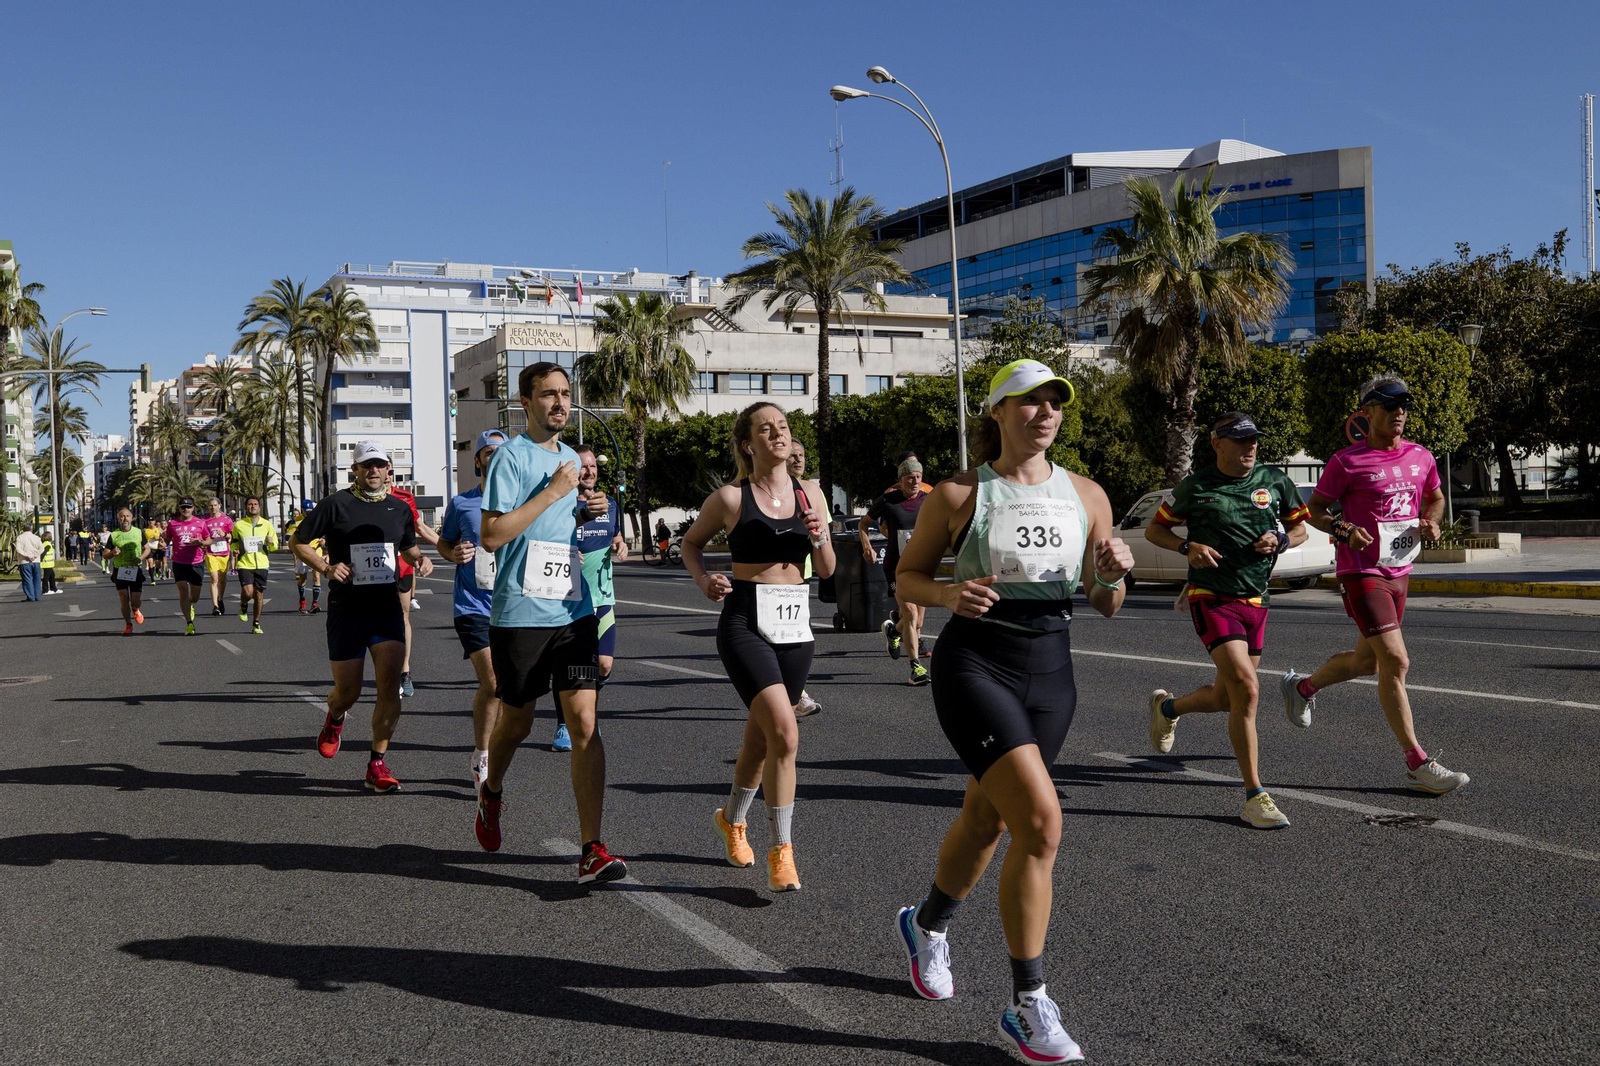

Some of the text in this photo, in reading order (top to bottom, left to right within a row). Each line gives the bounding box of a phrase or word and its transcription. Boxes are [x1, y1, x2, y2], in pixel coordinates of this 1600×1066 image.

[1249, 182, 1261, 191] DE
[510, 328, 549, 337] JEFATURA
[510, 337, 571, 347] POLICIA LOCAL
[1016, 526, 1063, 548] 338
[1393, 536, 1414, 549] 689
[364, 556, 387, 568] 187
[543, 561, 571, 578] 579
[776, 604, 801, 620] 117
